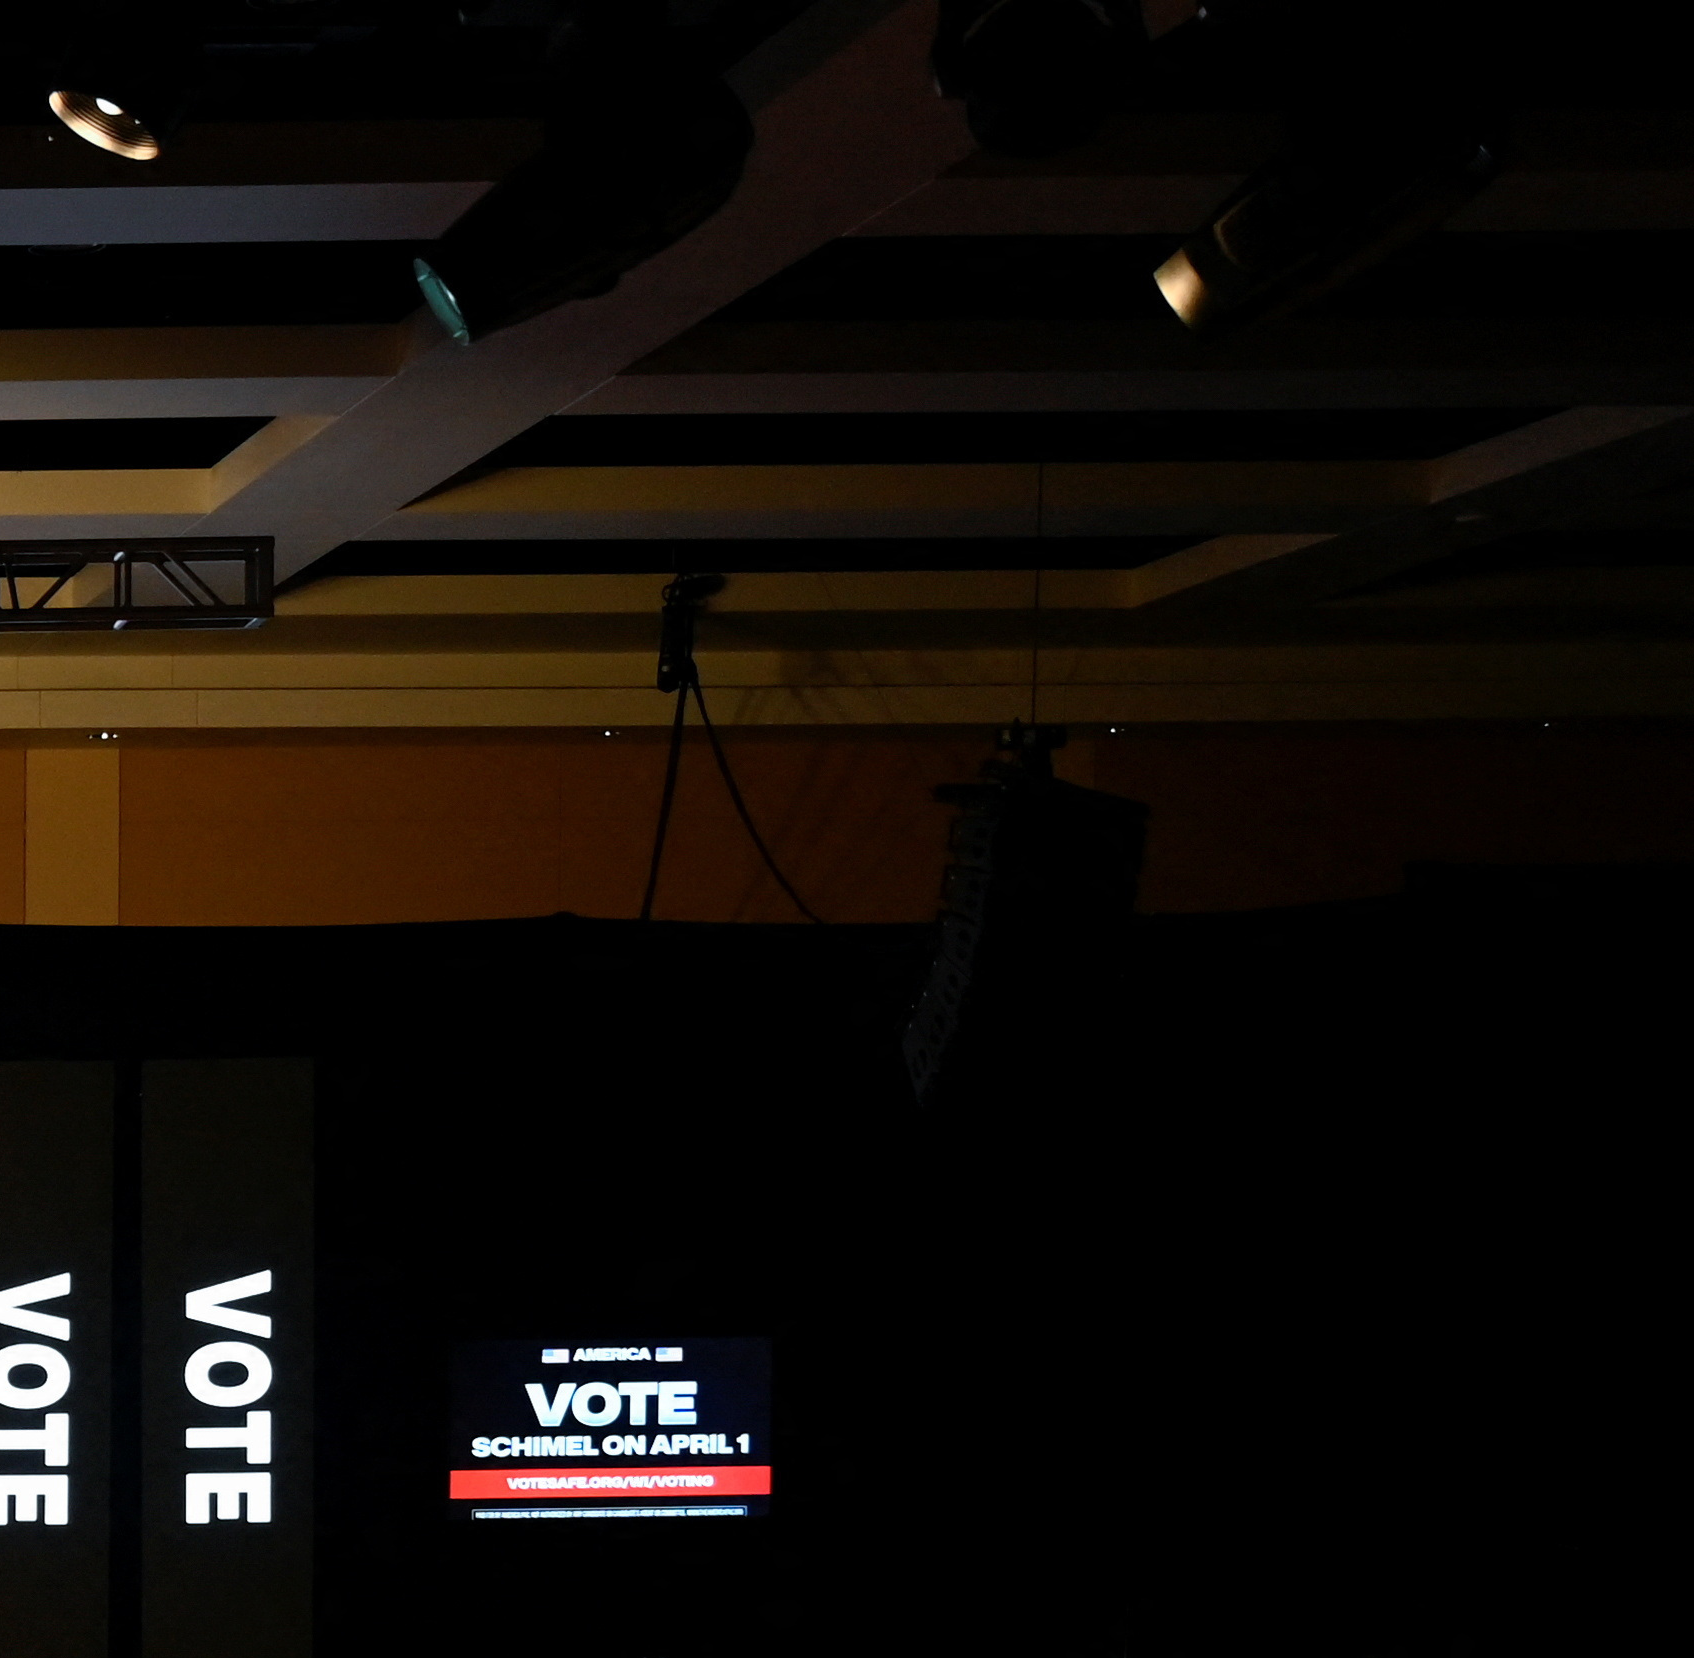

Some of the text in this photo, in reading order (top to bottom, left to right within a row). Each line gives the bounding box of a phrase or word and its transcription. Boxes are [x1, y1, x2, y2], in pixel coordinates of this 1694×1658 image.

[572, 1347, 652, 1362] AMERICA
[184, 1269, 273, 1524] VOTE
[524, 1381, 698, 1427] VOTE
[471, 1433, 750, 1458] SCHIMEL ON APRIL 1
[506, 1475, 715, 1491] VOTESAFE.ORG/WI/VOTING
